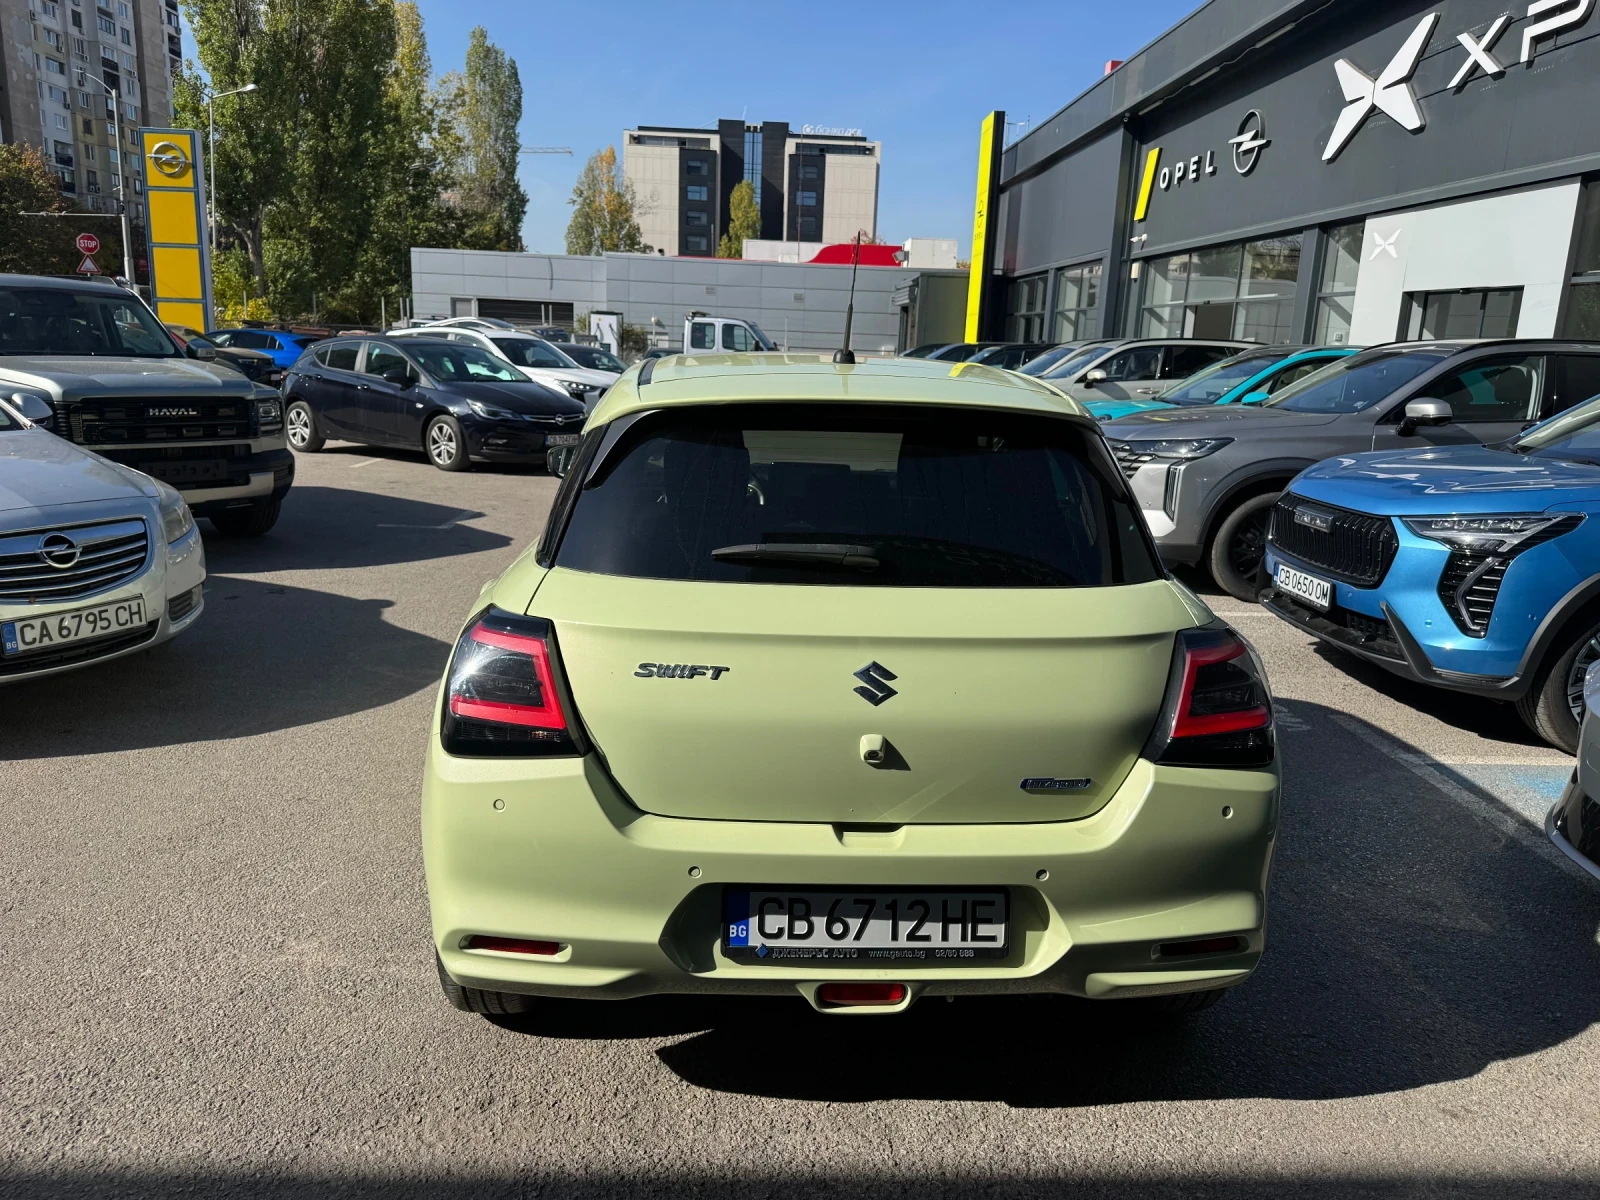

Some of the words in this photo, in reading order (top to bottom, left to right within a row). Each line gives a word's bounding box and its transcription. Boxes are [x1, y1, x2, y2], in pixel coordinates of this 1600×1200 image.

[1160, 150, 1214, 189] OPEL
[80, 240, 97, 248] STOP
[149, 408, 197, 416] HAVAL
[1278, 568, 1291, 586] CB
[1291, 573, 1314, 596] 0650
[1315, 583, 1330, 604] OM
[20, 620, 53, 646] CA
[57, 608, 111, 638] 6795
[115, 602, 142, 627] CH
[6, 641, 17, 650] BG
[634, 662, 731, 680] SWIFT
[757, 897, 815, 940] CB
[825, 898, 932, 942] 6712
[941, 899, 998, 942] HE
[729, 925, 747, 937] BG
[832, 948, 859, 958] АУТО
